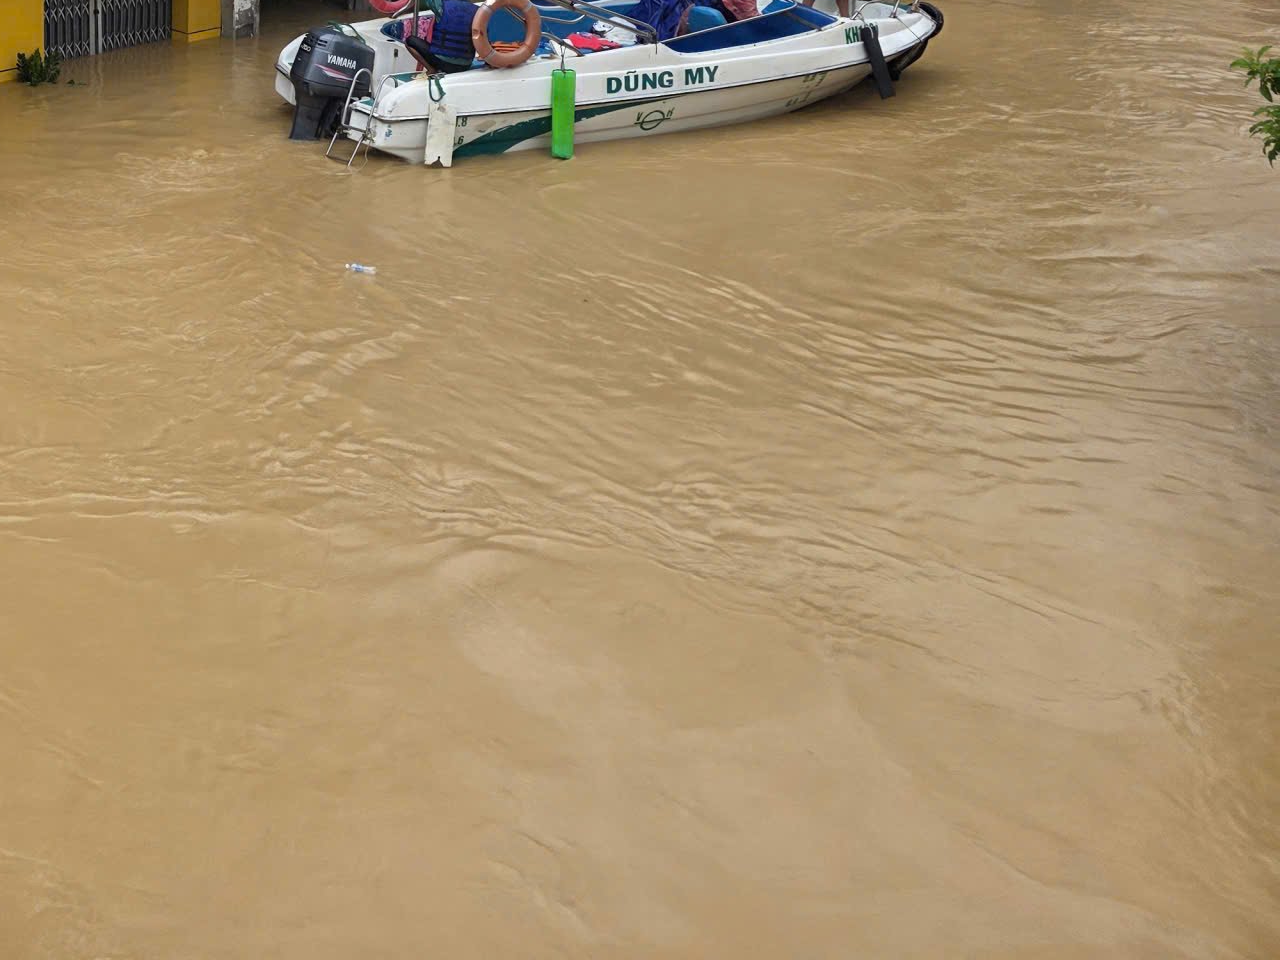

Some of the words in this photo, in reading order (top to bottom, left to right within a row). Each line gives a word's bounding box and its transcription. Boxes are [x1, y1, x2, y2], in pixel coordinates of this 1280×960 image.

[327, 53, 357, 70] YAMAHA
[606, 70, 674, 95] DŨNG
[684, 65, 719, 86] MY
